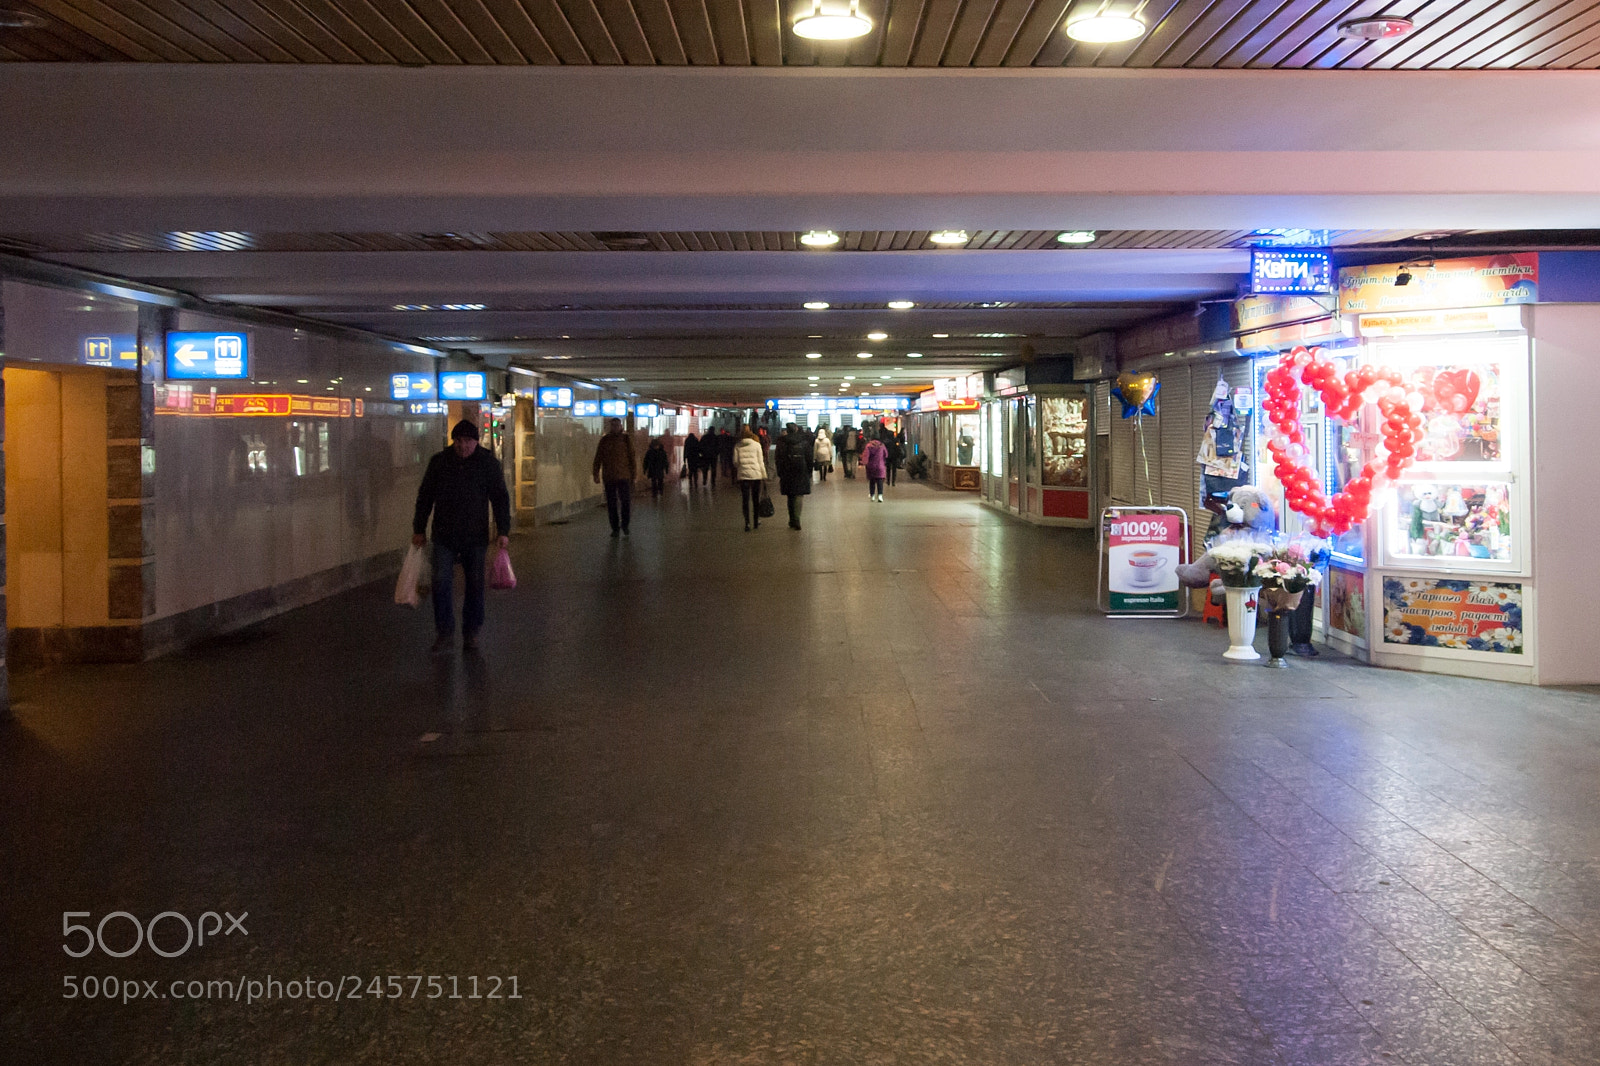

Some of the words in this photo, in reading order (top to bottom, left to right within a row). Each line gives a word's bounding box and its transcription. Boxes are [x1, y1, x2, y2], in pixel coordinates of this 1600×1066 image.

[1259, 259, 1308, 279] Квіти
[1497, 286, 1530, 299] cards
[217, 341, 237, 356] 11
[1121, 521, 1167, 536] 100%
